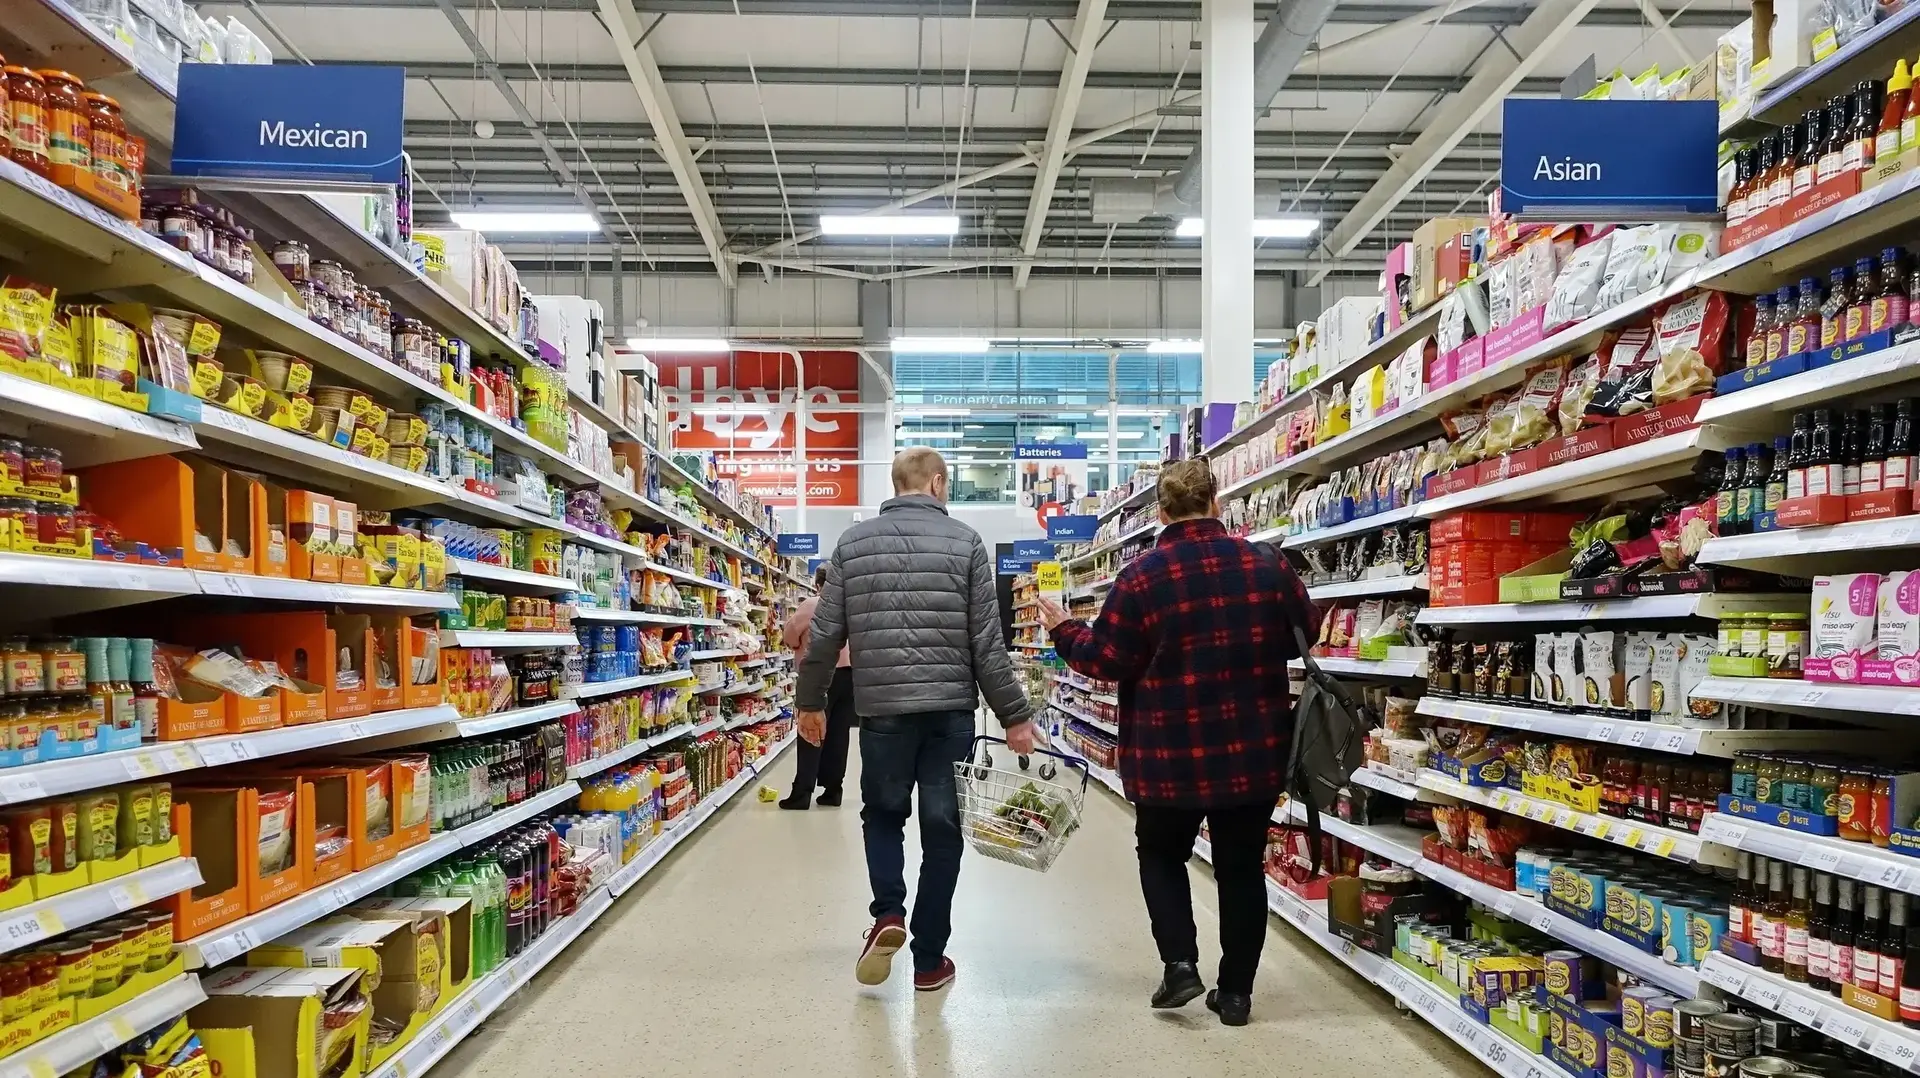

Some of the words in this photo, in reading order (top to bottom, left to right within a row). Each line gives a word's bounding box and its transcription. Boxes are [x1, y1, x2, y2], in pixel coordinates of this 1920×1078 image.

[259, 120, 368, 150] Mexican
[1533, 155, 1602, 182] Asian
[1878, 161, 1902, 176] TESCO
[1798, 202, 1815, 217] TASTE
[1821, 191, 1841, 208] CHINA
[1751, 224, 1769, 238] CHINA
[1685, 238, 1696, 246] 95
[1847, 342, 1864, 354] SAUCE
[1757, 367, 1771, 376] SAUCE
[999, 394, 1047, 405] Centre
[1644, 411, 1661, 420] TESCO
[1633, 423, 1655, 438] TASTE
[1654, 421, 1665, 433] OF
[1665, 414, 1692, 429] CHINA
[1019, 448, 1062, 457] Batteries
[1554, 448, 1572, 460] TASTE
[1578, 440, 1599, 454] CHINA
[815, 456, 841, 473] us
[1510, 462, 1527, 473] CHINA
[1452, 479, 1466, 489] CHINA
[1798, 509, 1812, 517] CHINA
[1874, 506, 1891, 514] CHINA
[1448, 560, 1462, 568] Fortune
[1042, 571, 1056, 579] Half
[1448, 568, 1462, 577] Cookies
[1851, 589, 1860, 602] 5
[1900, 586, 1908, 600] 5
[1824, 610, 1841, 619] itsu
[63, 667, 79, 676] SALSA
[1803, 691, 1822, 702] £2
[178, 720, 197, 731] TASTE
[1597, 727, 1612, 738] £2
[1630, 731, 1645, 743] £2
[1667, 735, 1683, 749] £2
[231, 740, 249, 759] £1
[1742, 804, 1757, 814] PASTE
[1793, 816, 1809, 826] PASTE
[1727, 829, 1742, 839] £1.99
[1820, 852, 1838, 863] £1.99
[1880, 867, 1904, 884] £1
[334, 888, 349, 906] £1
[210, 898, 224, 909] TESCO
[197, 914, 213, 927] TASTE
[221, 903, 240, 918] MEXICO
[8, 919, 40, 938] £1.99
[1539, 917, 1550, 929] £2
[234, 930, 253, 950] £1
[1389, 975, 1406, 992] £1.45
[1726, 975, 1742, 987] £2.99
[1762, 989, 1778, 1002] £1.99
[1852, 991, 1878, 1006] TESCO
[1418, 994, 1437, 1013] £1.45
[1798, 1005, 1815, 1018] £2.39
[1456, 1021, 1477, 1041] £1.44
[1843, 1025, 1863, 1038] £1.90
[1487, 1043, 1507, 1065] 95p
[1894, 1045, 1915, 1060] 99p
